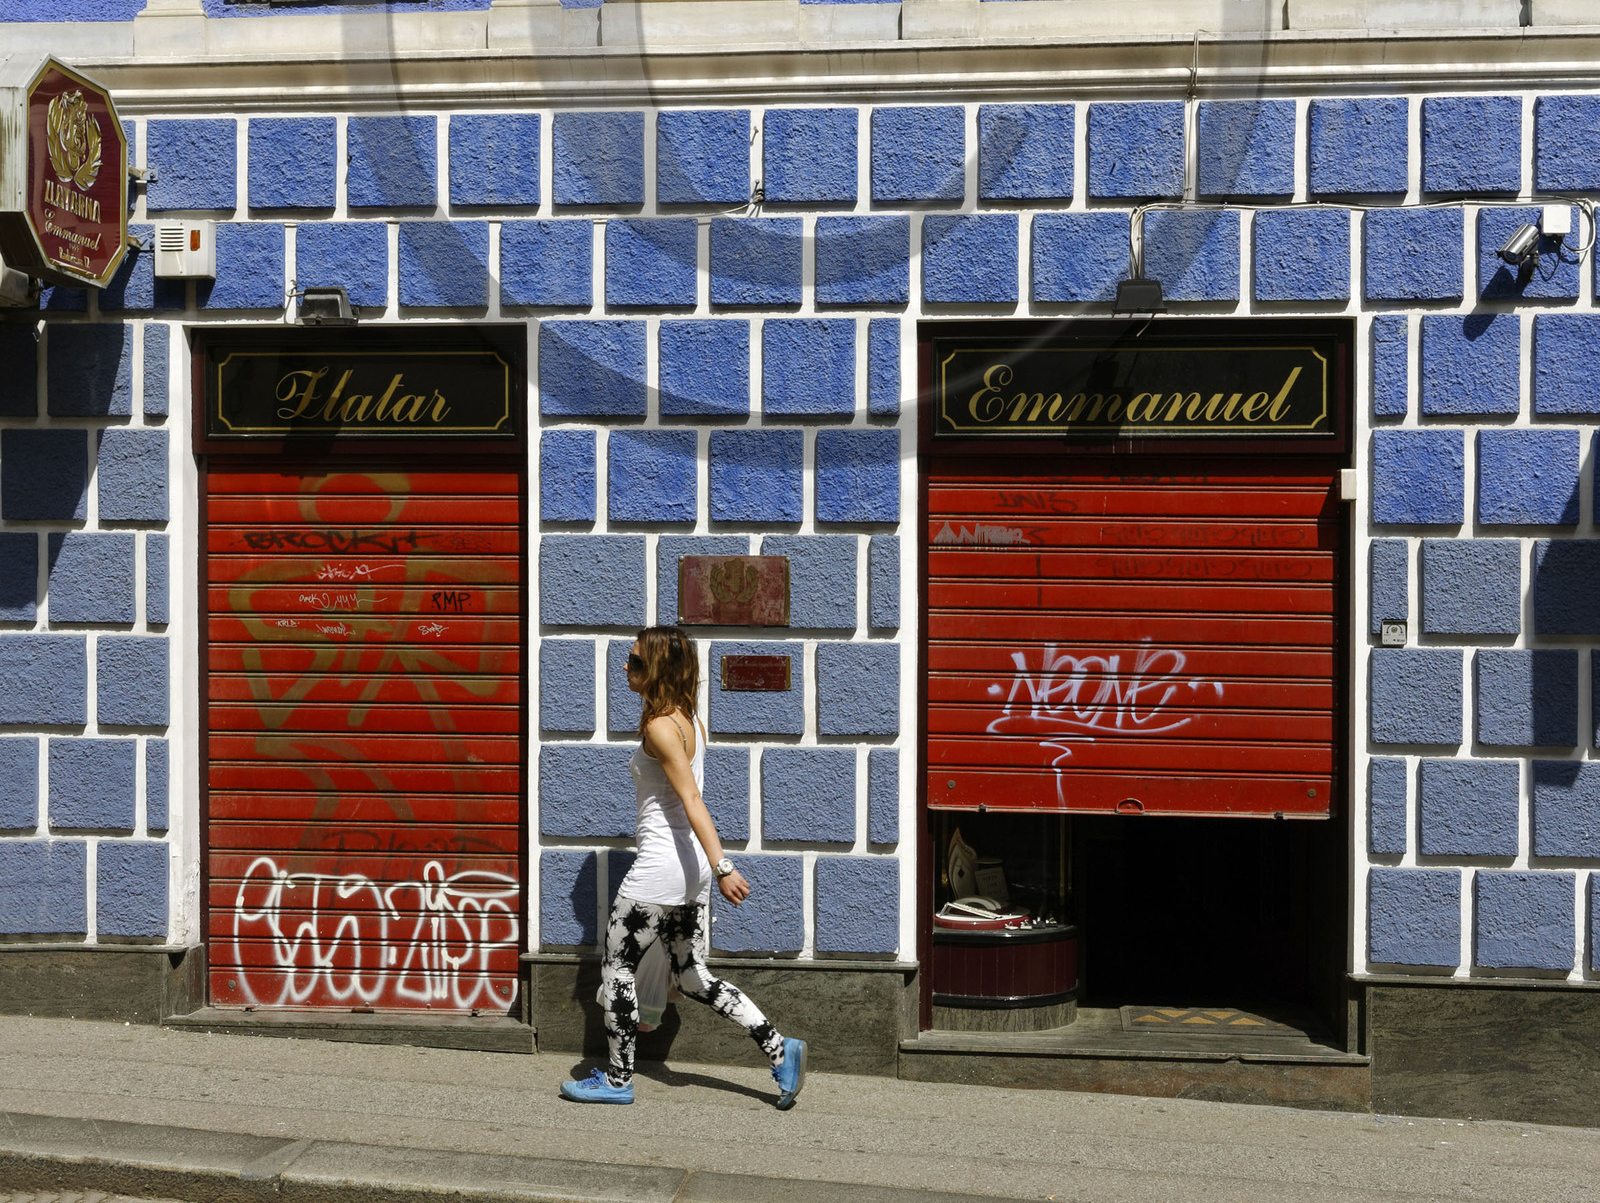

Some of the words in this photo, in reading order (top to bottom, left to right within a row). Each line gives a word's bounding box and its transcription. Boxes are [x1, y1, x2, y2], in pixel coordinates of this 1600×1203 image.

[44, 179, 101, 224] ZLATARNA
[44, 208, 102, 251] Emmanuel
[275, 365, 451, 423] Zlatar
[968, 364, 1303, 423] Emmanuel
